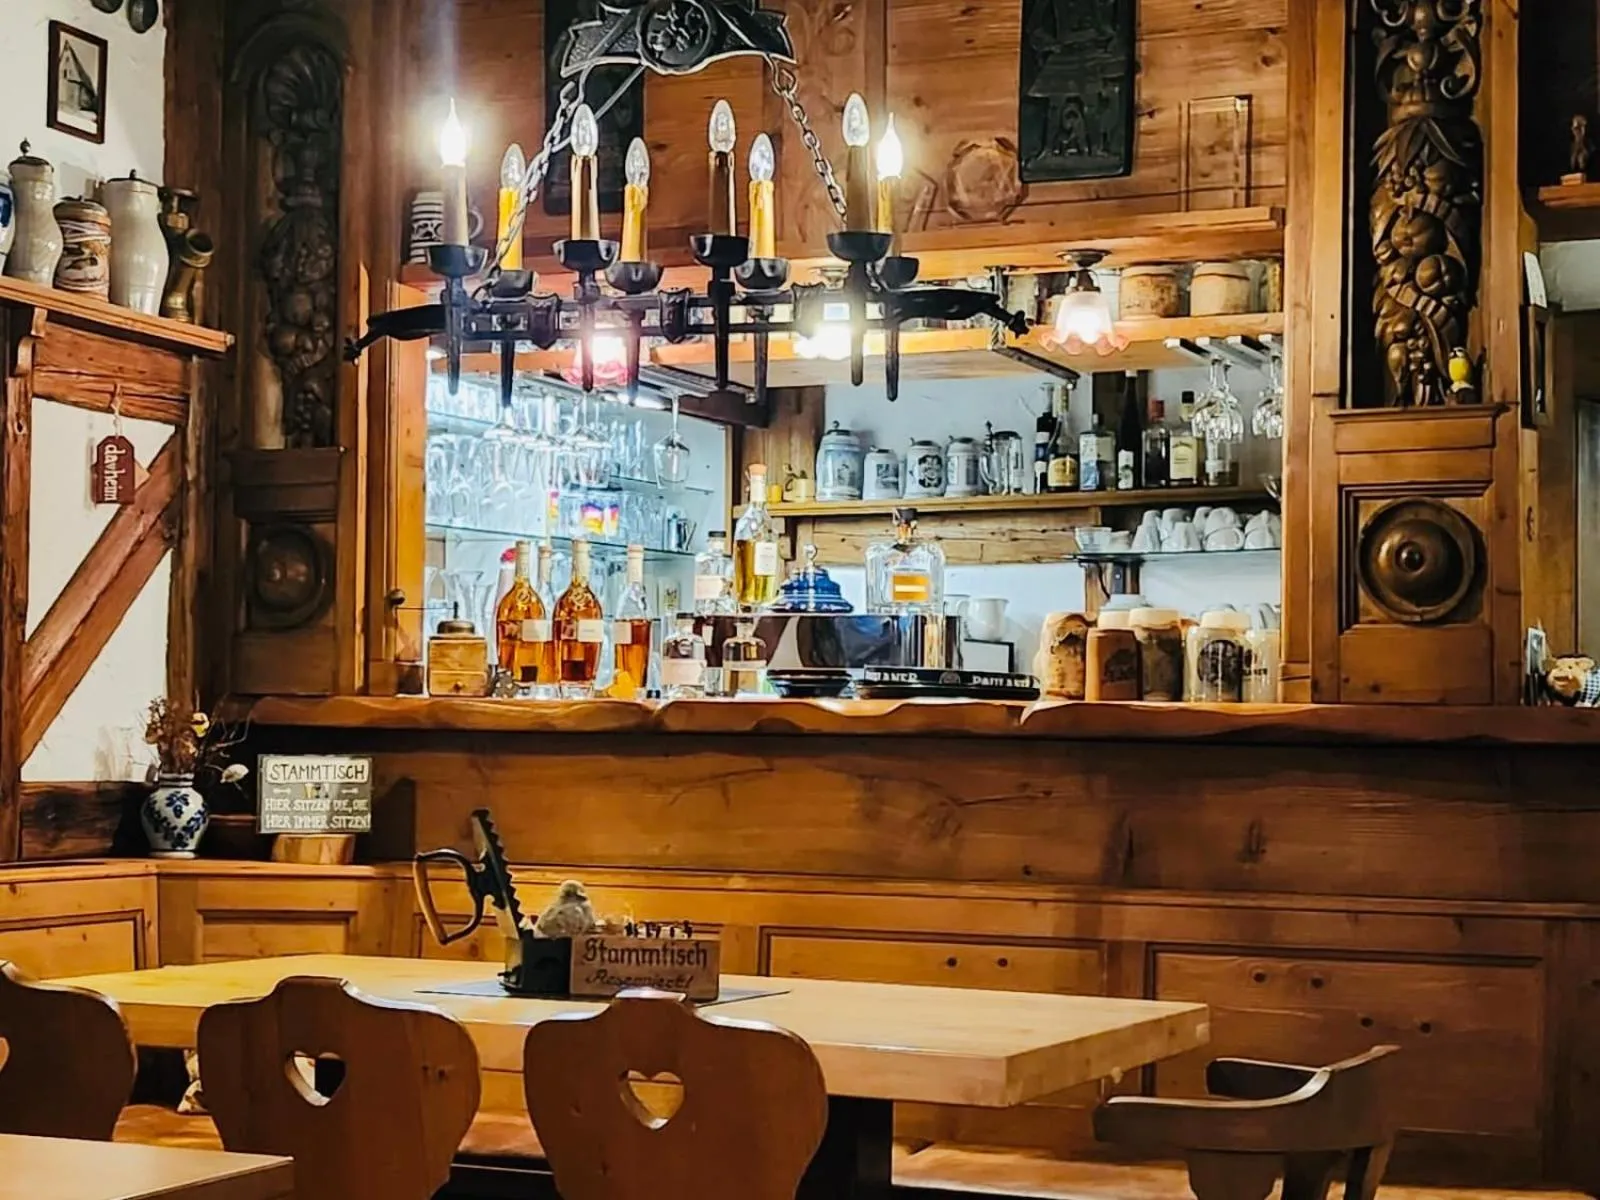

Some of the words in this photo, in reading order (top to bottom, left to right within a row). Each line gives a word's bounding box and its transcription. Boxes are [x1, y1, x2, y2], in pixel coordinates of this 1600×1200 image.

[270, 763, 365, 781] STAMMTISCH
[265, 798, 291, 812] HIER
[293, 799, 331, 812] SITZEN
[265, 815, 291, 829] HIER
[582, 936, 708, 969] Stammtisch
